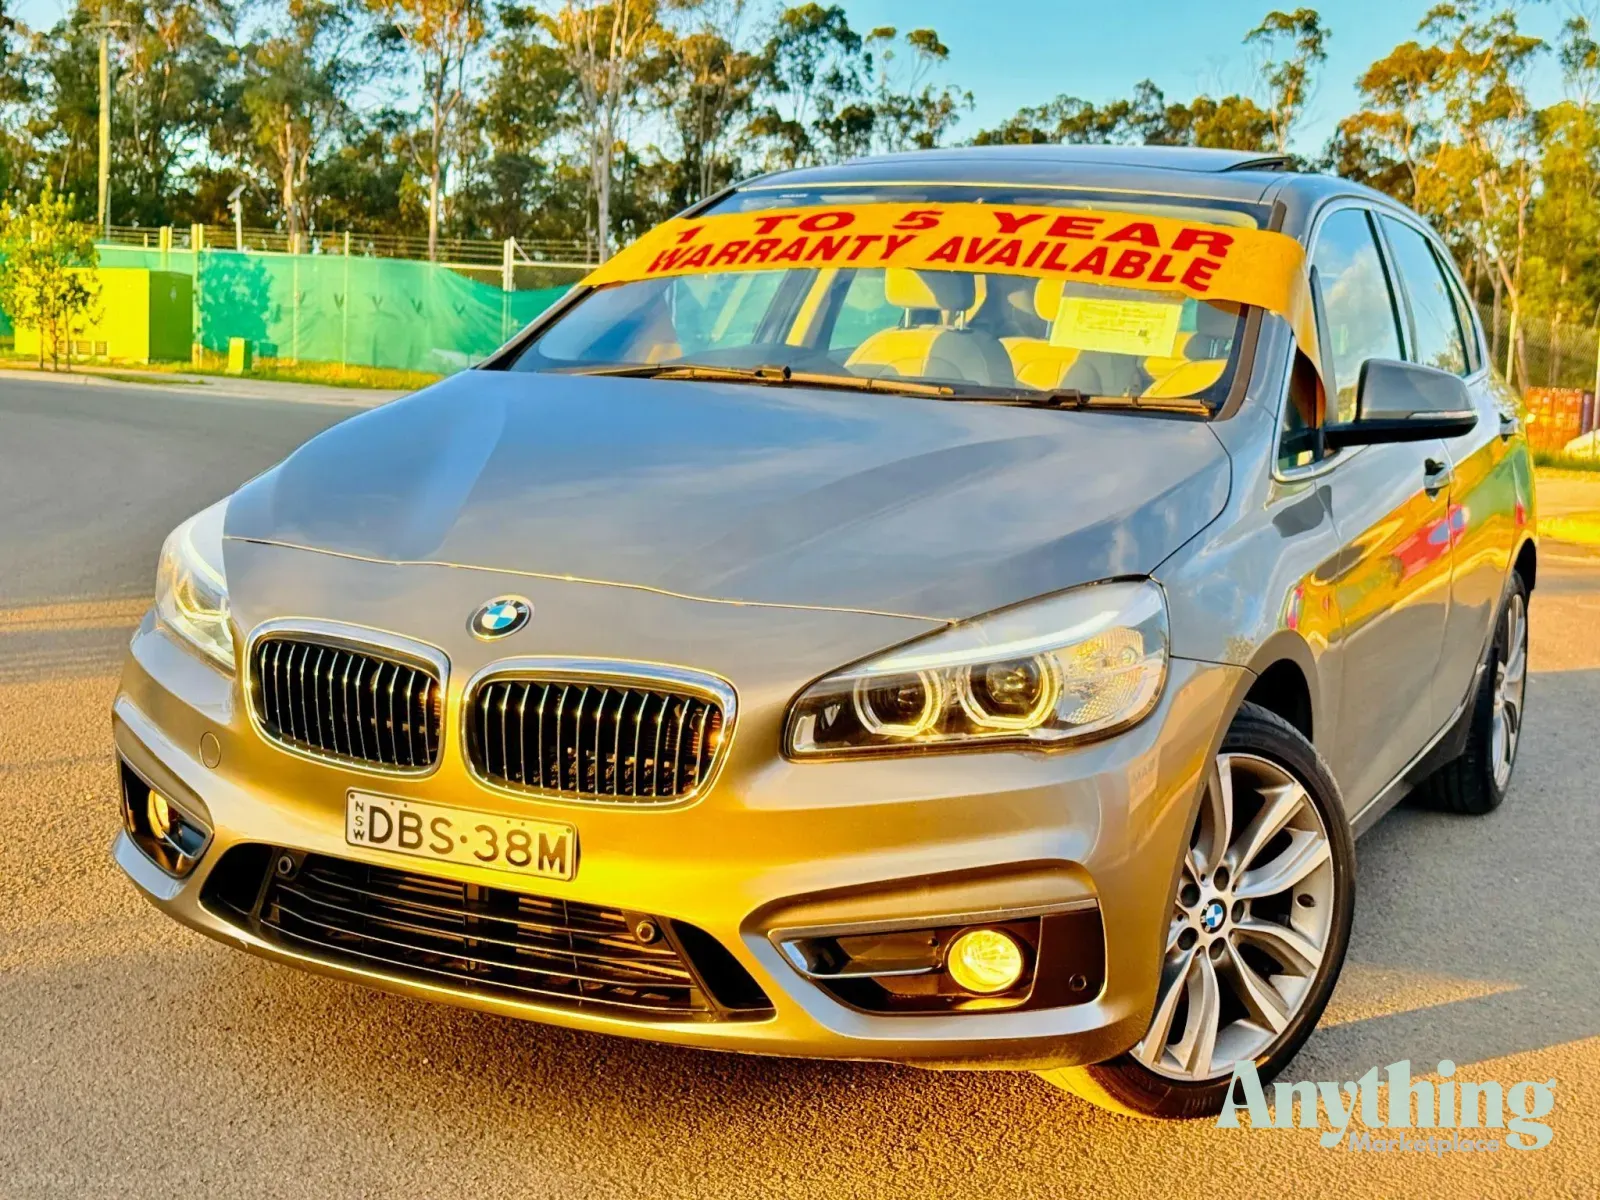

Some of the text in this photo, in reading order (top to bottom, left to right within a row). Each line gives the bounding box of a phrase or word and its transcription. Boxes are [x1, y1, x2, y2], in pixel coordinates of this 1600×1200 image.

[677, 209, 1235, 259] 1 TO 5 YEAR
[646, 234, 1222, 293] WARRANTY AVAILABLE
[353, 800, 366, 841] NSW
